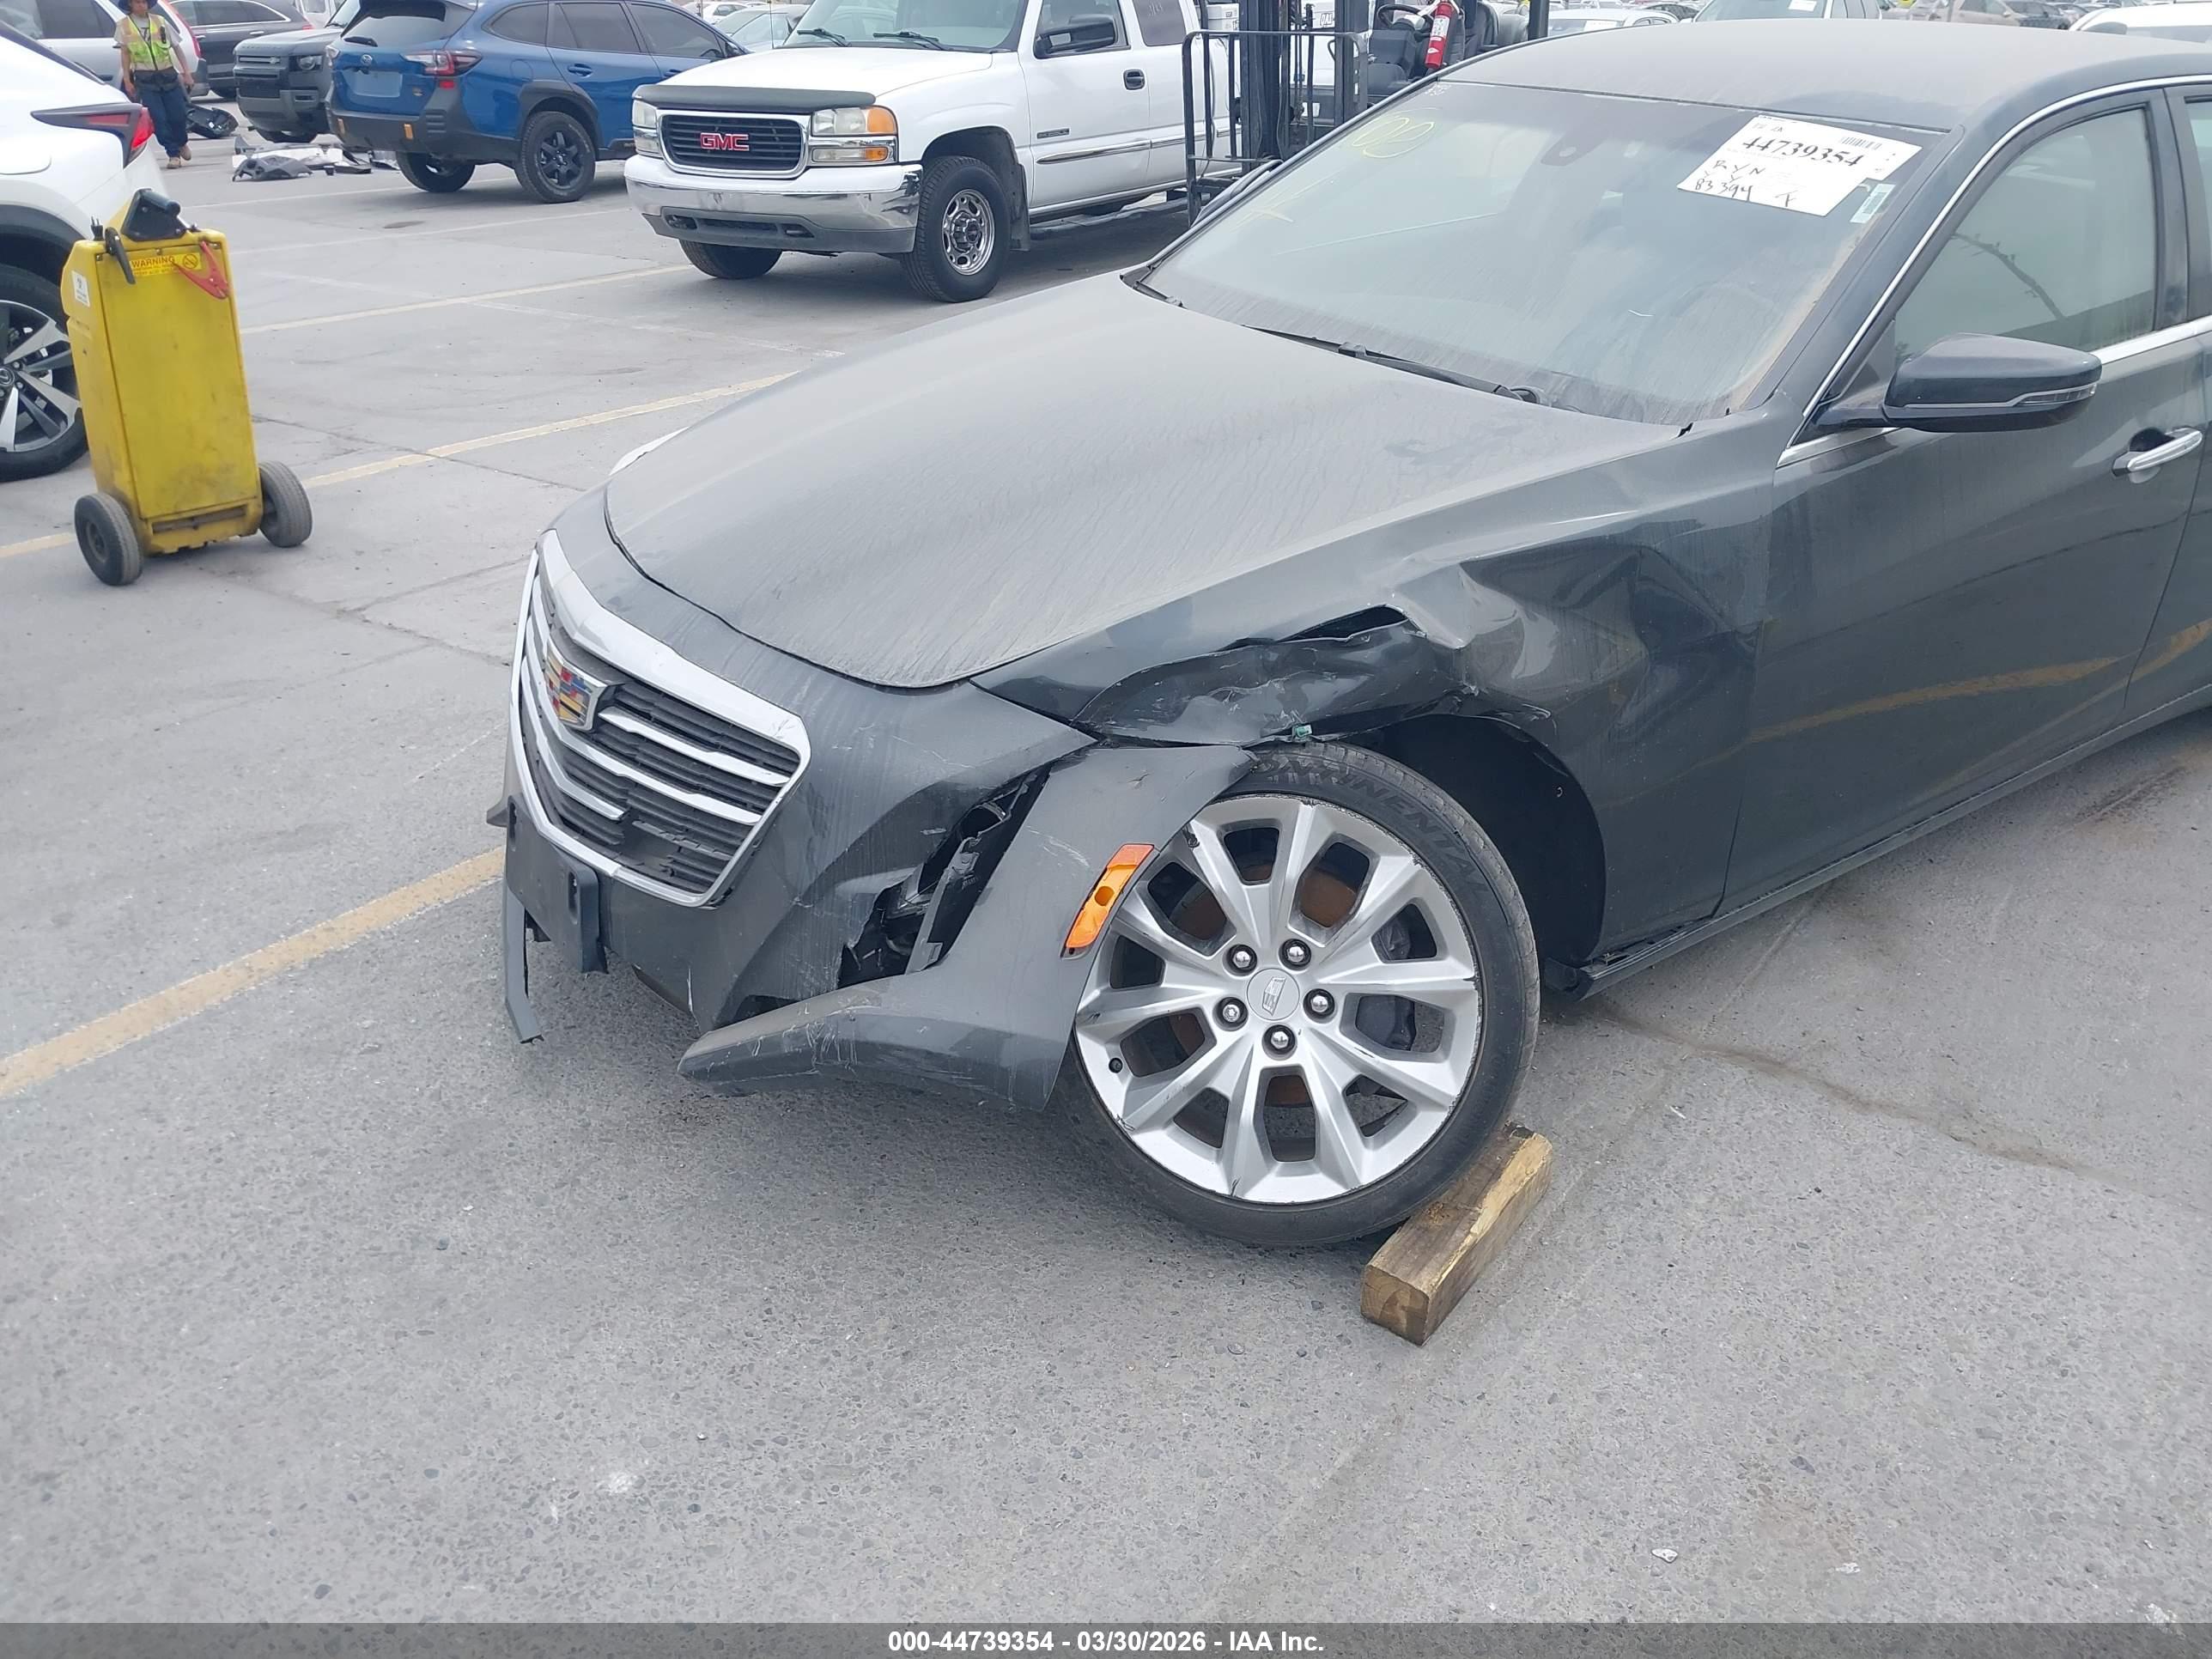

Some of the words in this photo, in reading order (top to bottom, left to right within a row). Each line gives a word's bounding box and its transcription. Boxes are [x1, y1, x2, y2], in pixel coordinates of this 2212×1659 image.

[700, 132, 750, 151] GMC
[1742, 135, 1864, 167] 44739354
[131, 256, 175, 268] WARNING
[1255, 755, 1490, 895] ONTINENTAL
